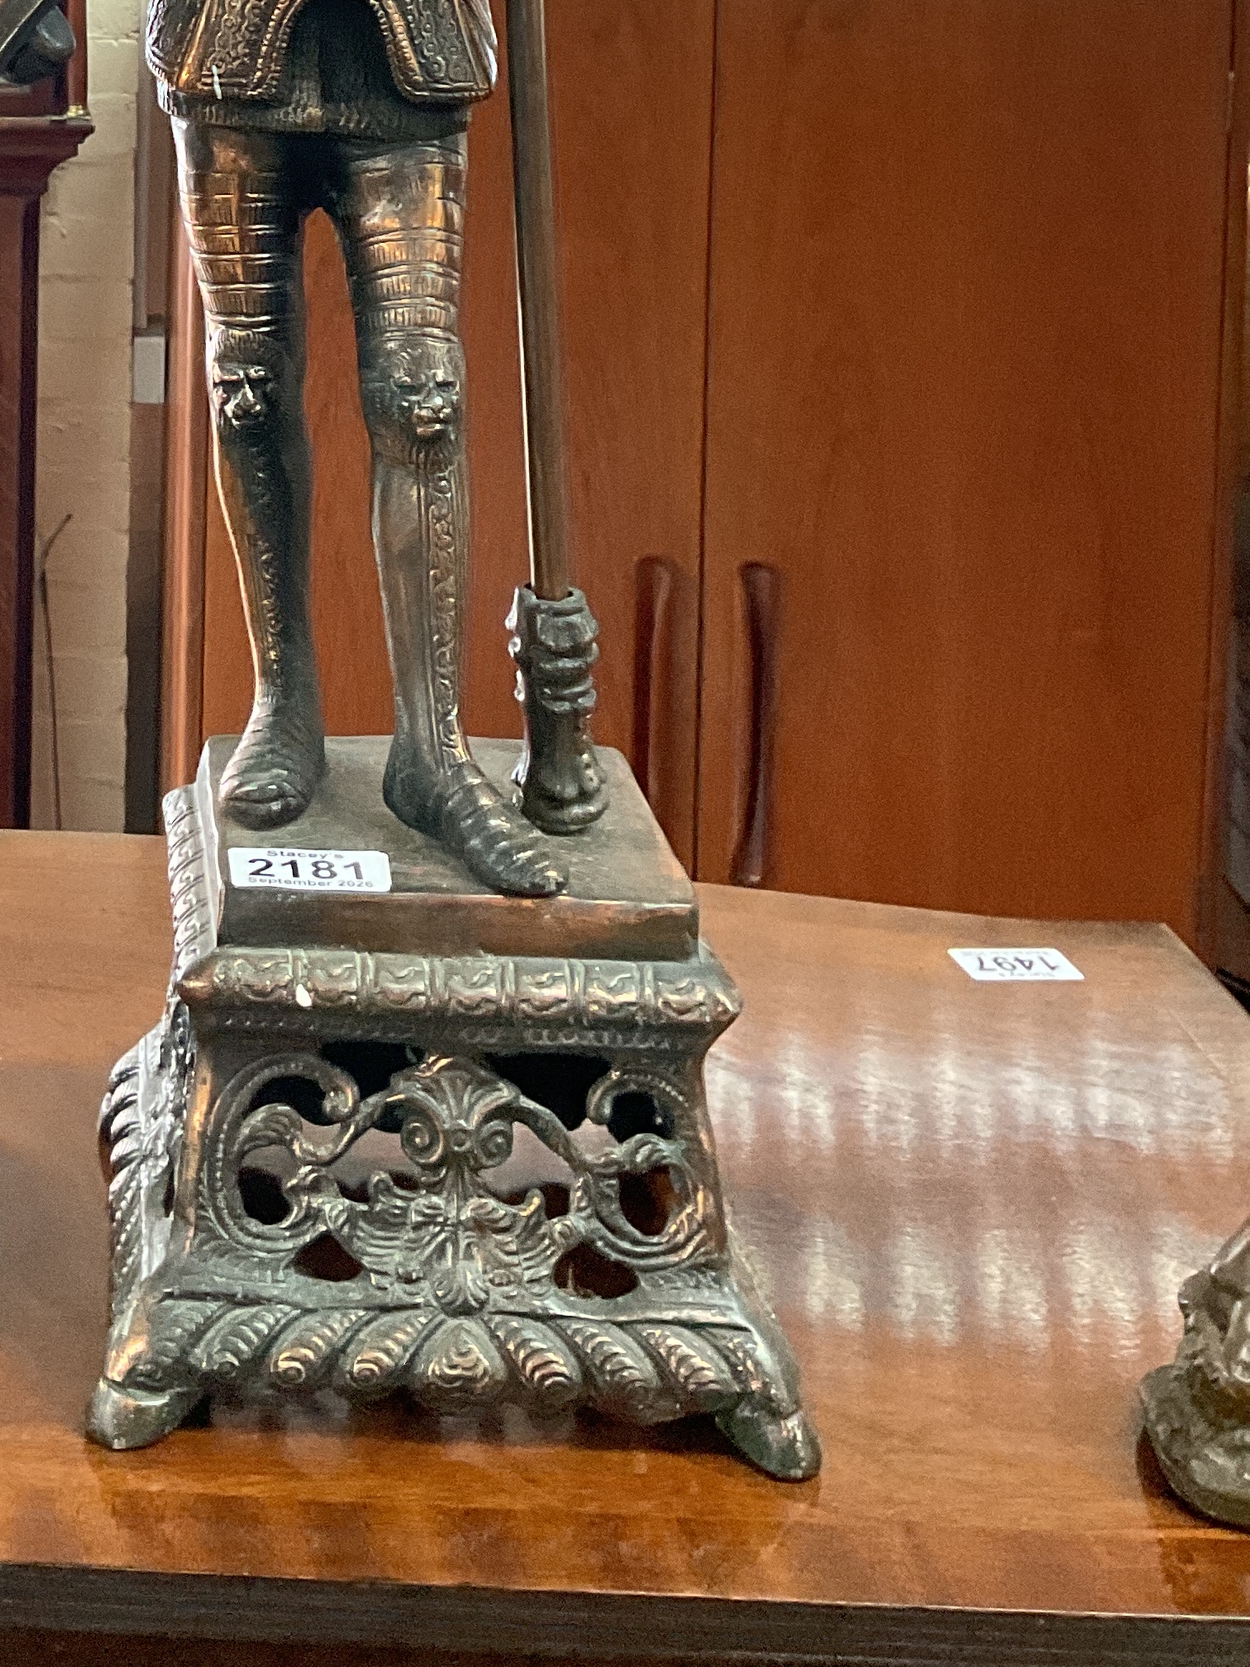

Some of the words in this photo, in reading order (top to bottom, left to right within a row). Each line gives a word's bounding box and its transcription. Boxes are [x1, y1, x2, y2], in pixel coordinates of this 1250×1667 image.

[267, 850, 344, 859] Stacey's
[248, 858, 364, 880] 2181
[248, 877, 331, 887] September
[978, 956, 1059, 971] 1497
